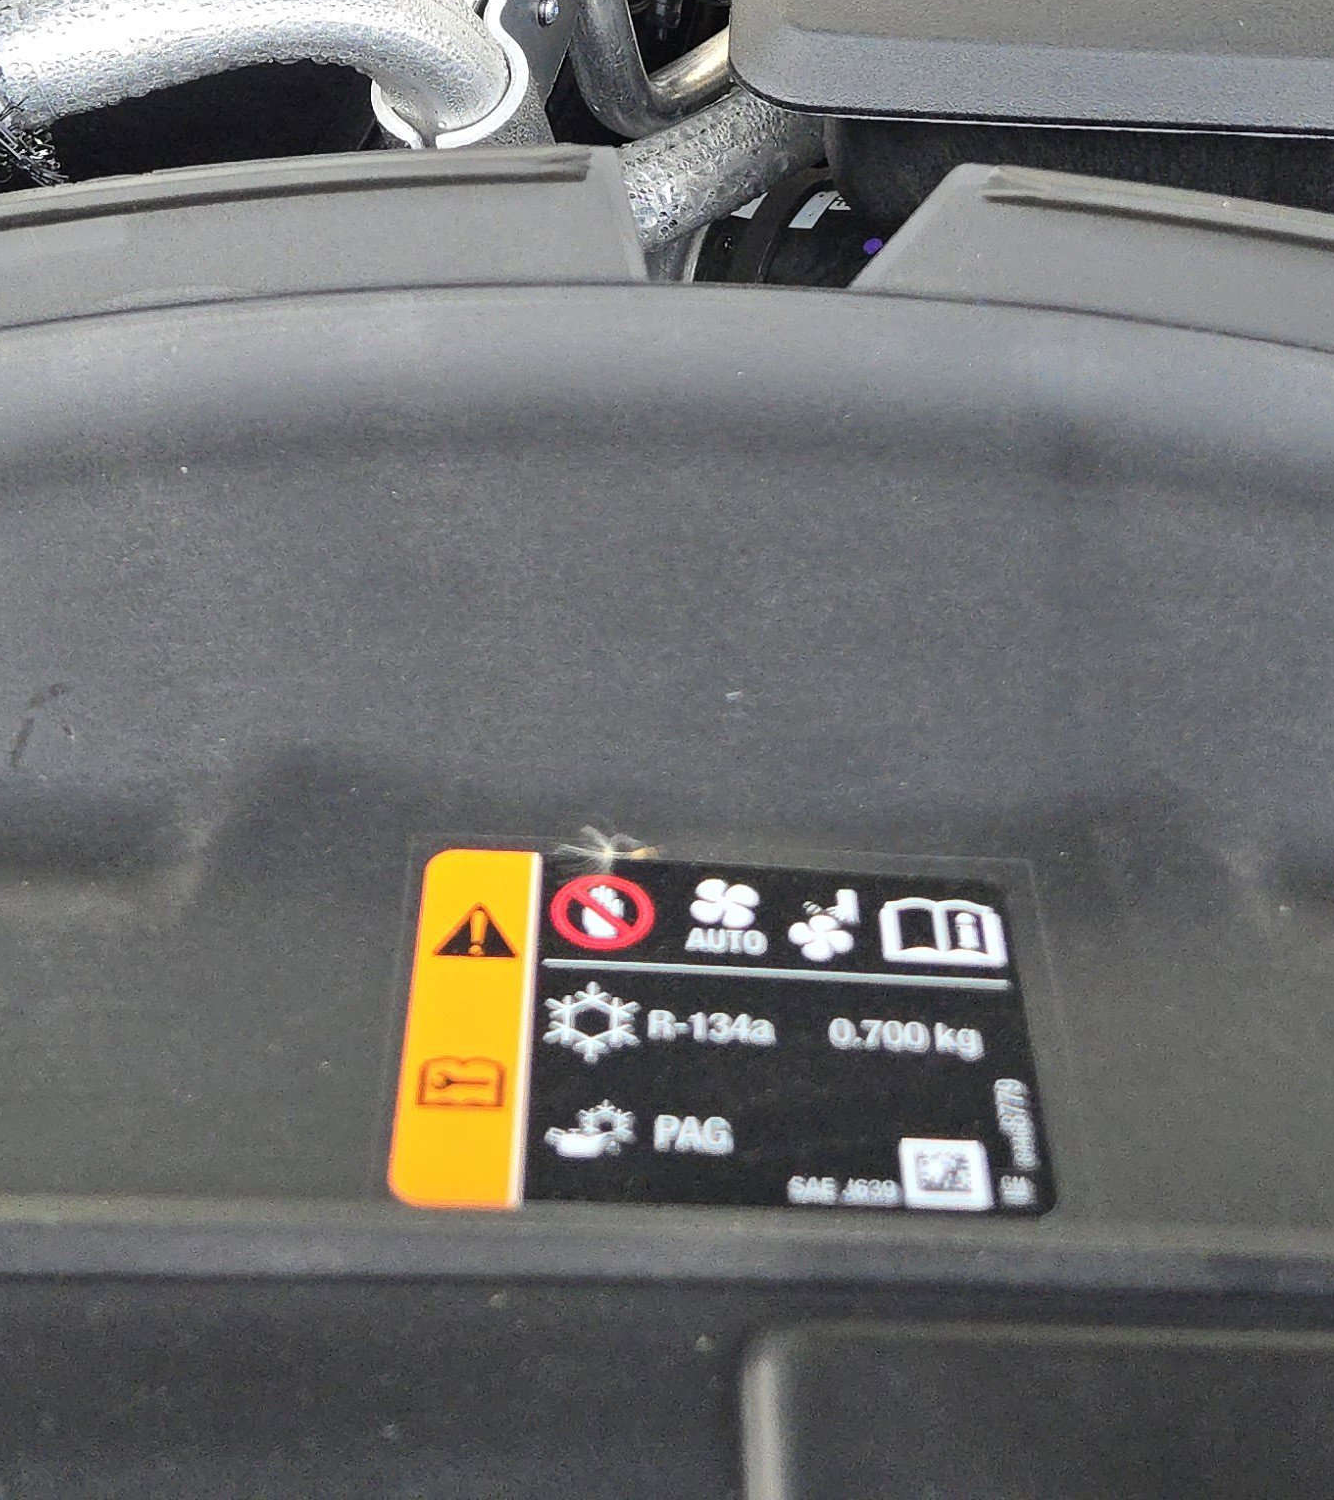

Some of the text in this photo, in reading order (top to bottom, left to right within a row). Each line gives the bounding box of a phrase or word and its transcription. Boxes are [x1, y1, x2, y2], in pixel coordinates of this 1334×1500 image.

[685, 928, 768, 955] AUTO
[647, 1009, 985, 1062] R-134a 0.700 kg
[653, 1114, 735, 1155] PAG
[787, 1175, 838, 1204] SAE
